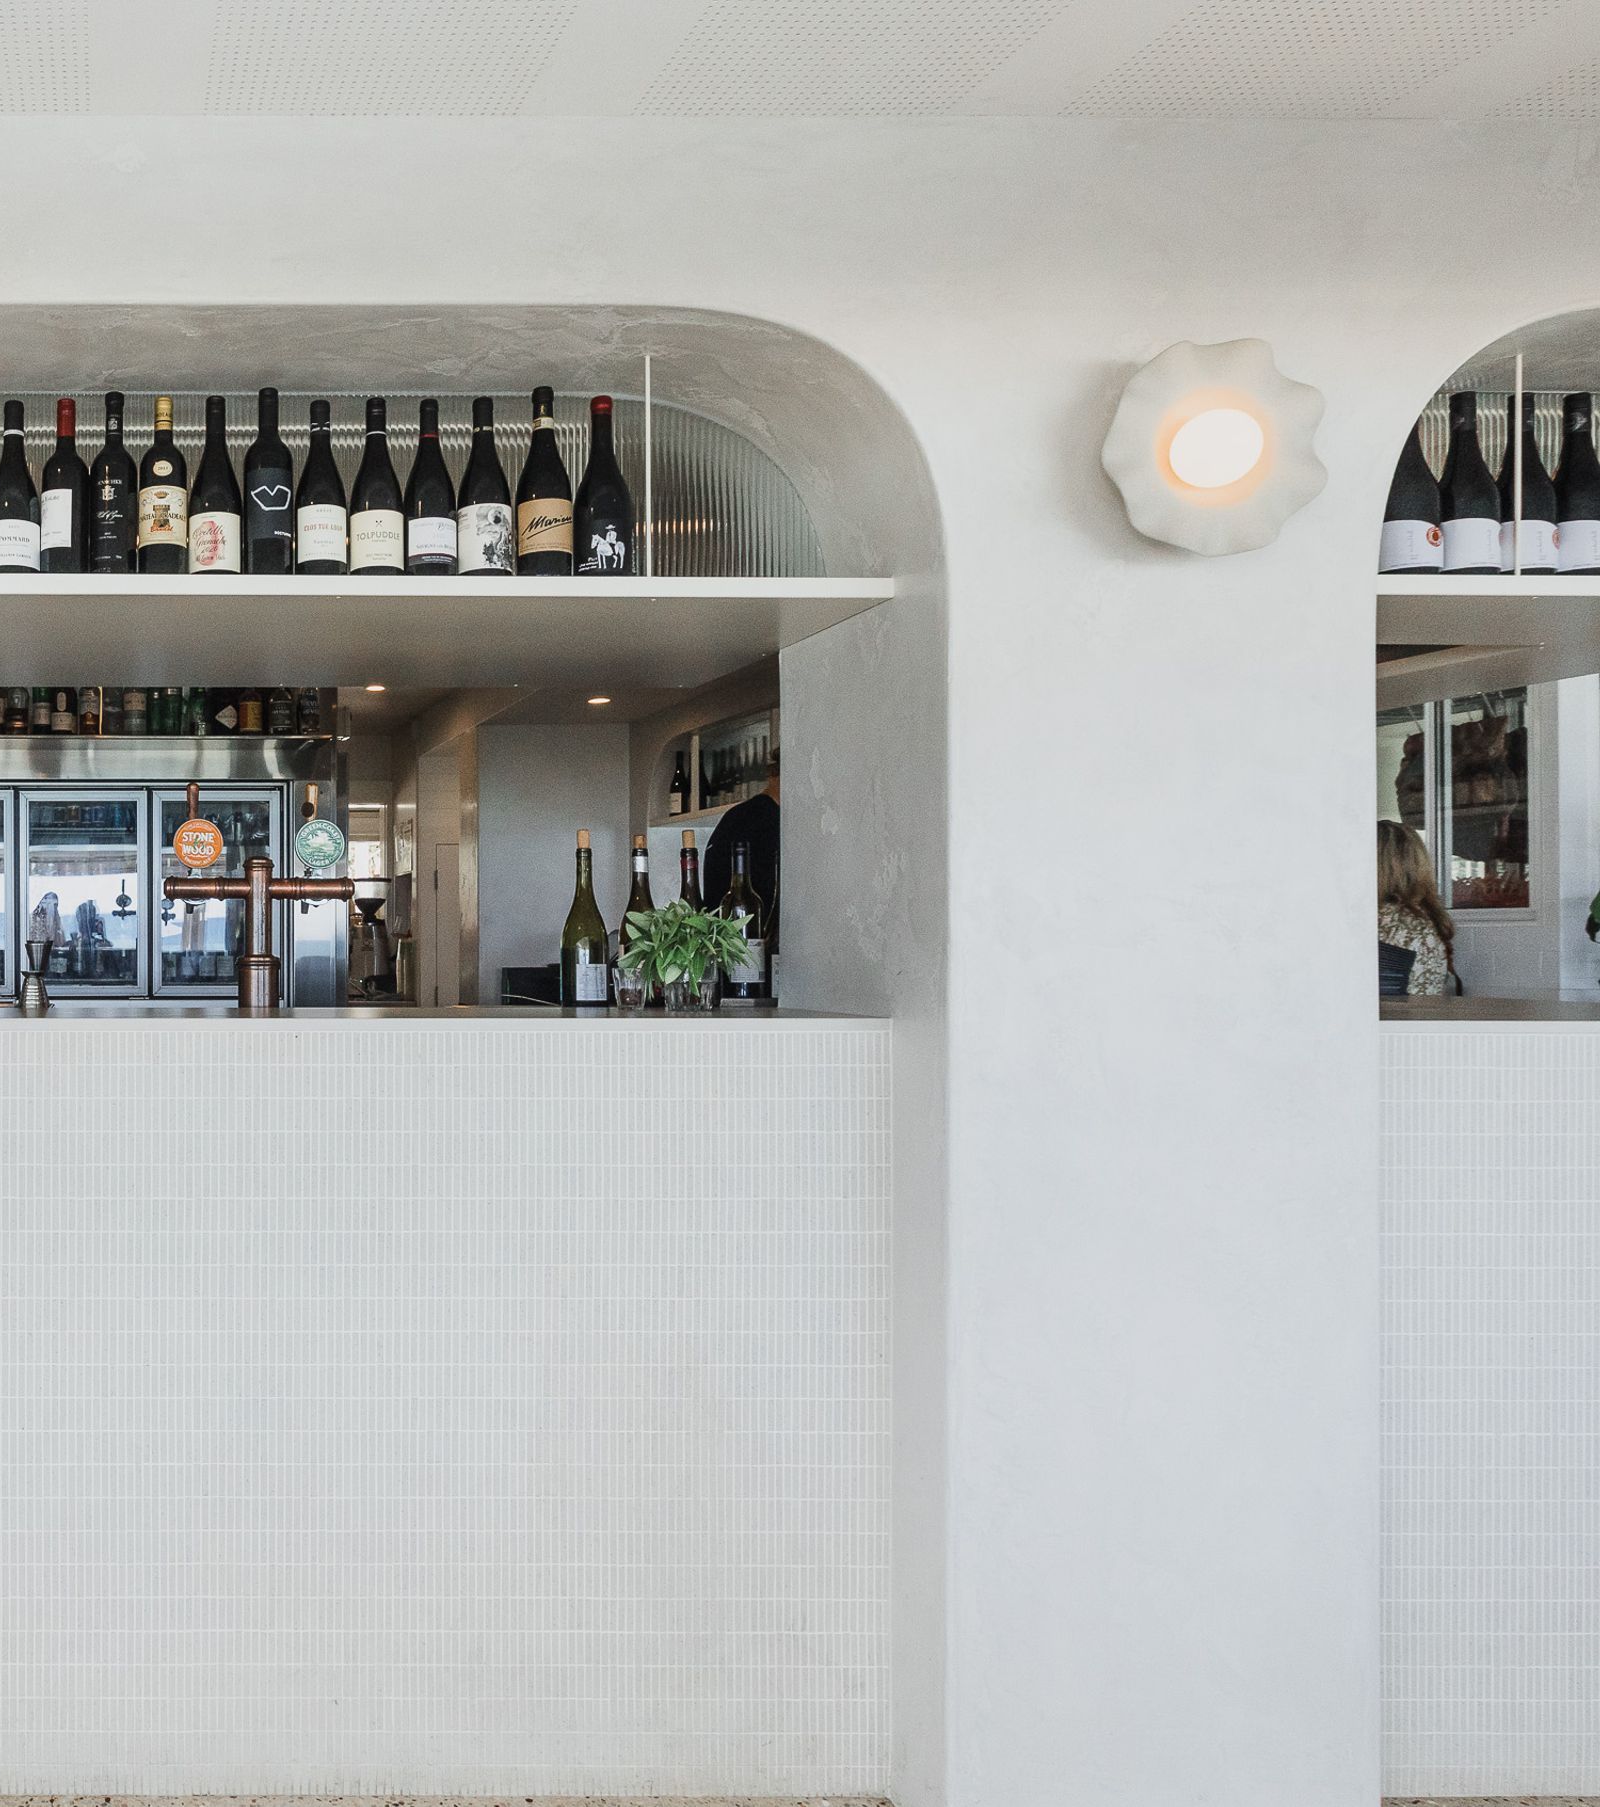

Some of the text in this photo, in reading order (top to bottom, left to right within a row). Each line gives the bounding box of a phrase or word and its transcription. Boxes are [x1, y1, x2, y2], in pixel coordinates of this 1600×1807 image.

[356, 530, 400, 541] TOLPUDDLE
[182, 832, 215, 842] STONE
[182, 844, 216, 855] WOOD
